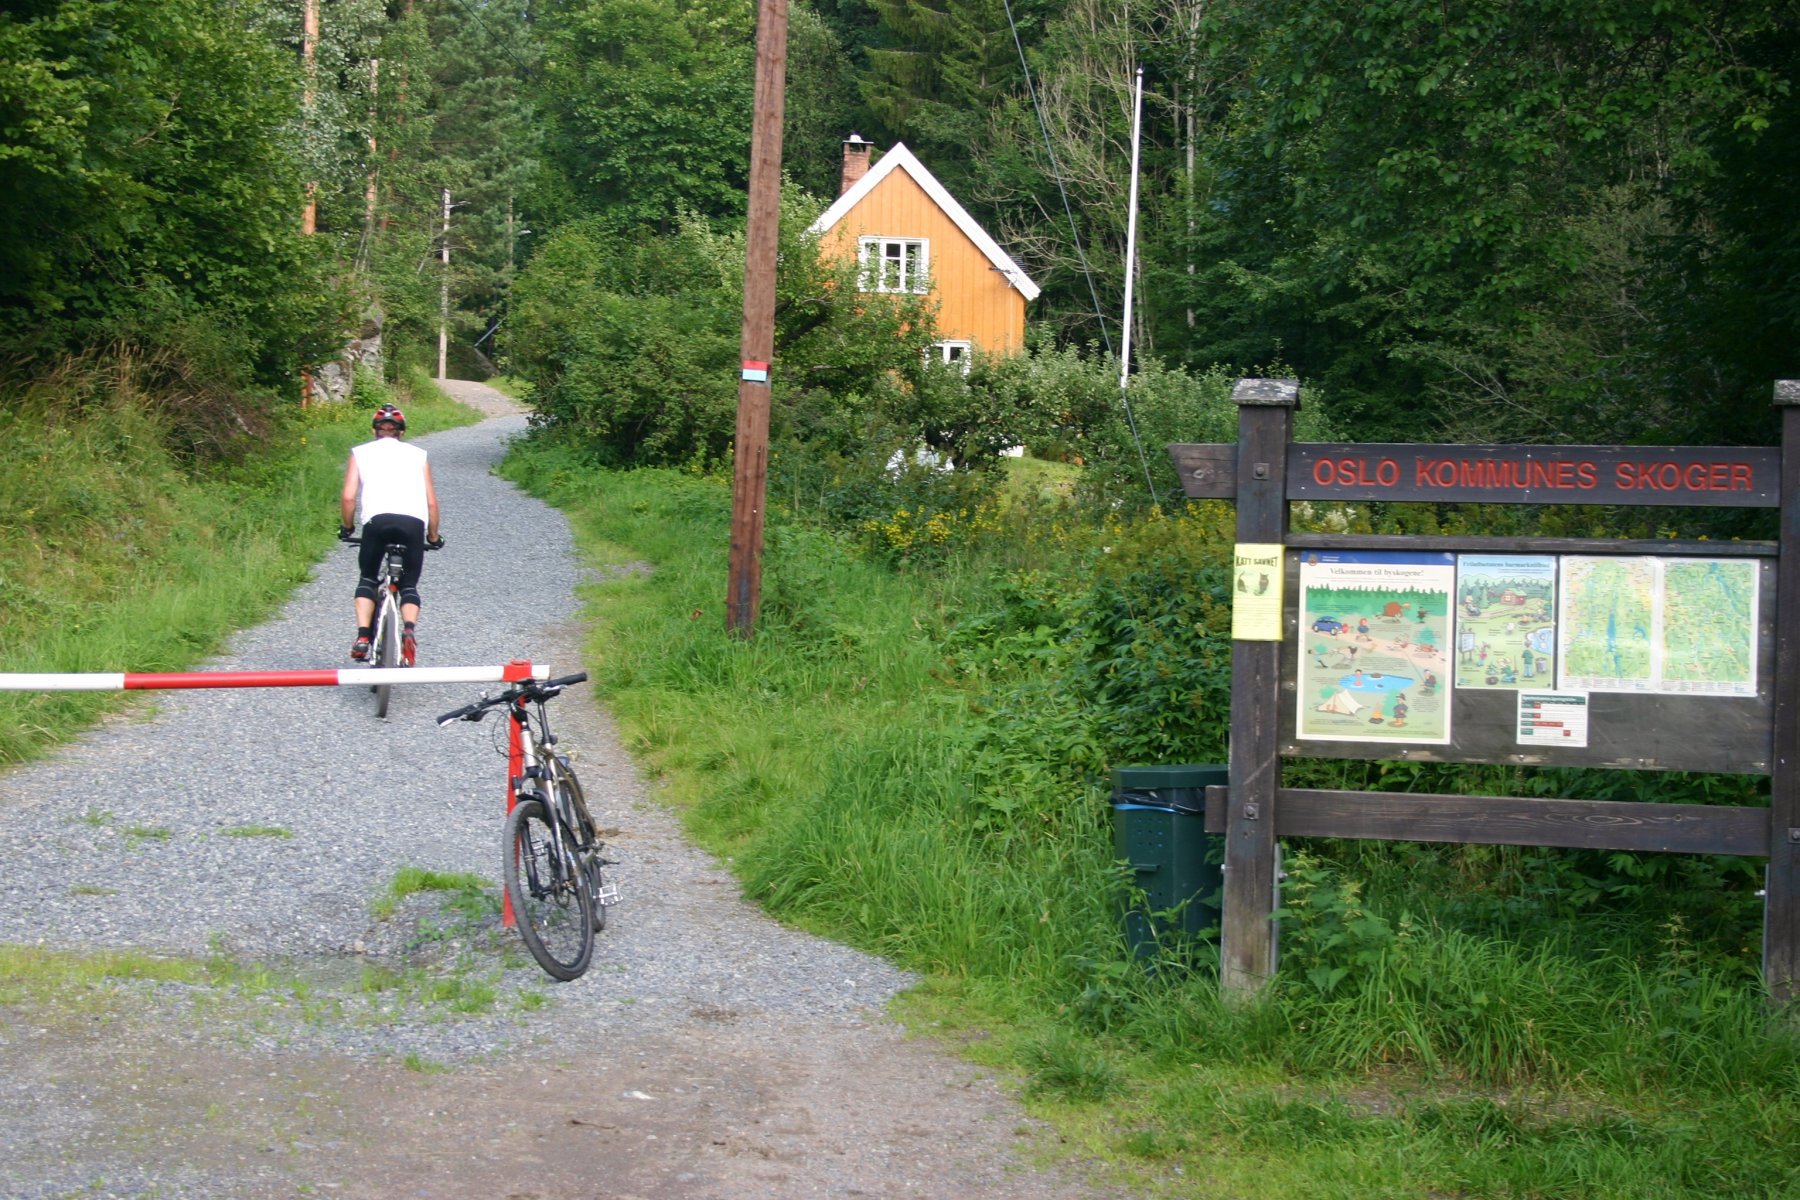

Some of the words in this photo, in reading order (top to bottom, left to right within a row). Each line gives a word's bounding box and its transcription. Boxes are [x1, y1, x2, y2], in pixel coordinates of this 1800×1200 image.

[1313, 457, 1399, 486] OSLO
[1415, 458, 1598, 489] KOMMUNES
[1615, 461, 1754, 491] SKOGER
[1236, 555, 1252, 567] KATT
[1330, 567, 1372, 576] Velkommen
[1374, 568, 1382, 576] til
